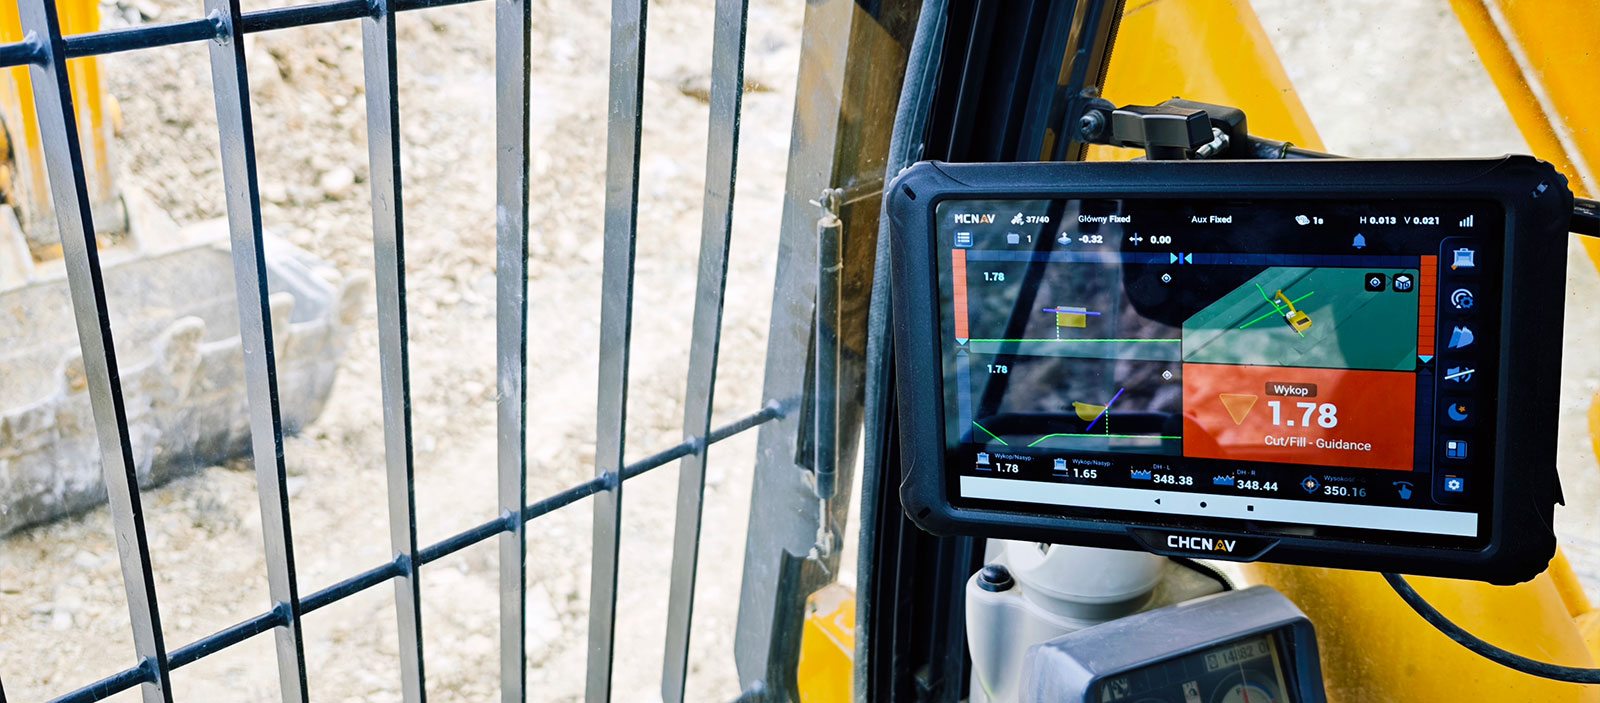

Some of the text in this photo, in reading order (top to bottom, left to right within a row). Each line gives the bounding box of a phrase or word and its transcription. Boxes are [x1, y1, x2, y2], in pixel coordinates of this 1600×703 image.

[954, 213, 996, 225] MCNAV
[1025, 215, 1050, 224] 37/40
[1078, 213, 1131, 225] Główny Fixed
[1191, 215, 1232, 225] Aux Fixed
[1312, 216, 1324, 225] 1s
[1359, 216, 1440, 225] H 0.013 V 0.021
[1026, 235, 1032, 243] 1
[1078, 235, 1103, 243] -0.32
[1150, 236, 1172, 244] 0.00
[983, 272, 1005, 282] 1.78
[986, 364, 1008, 374] 1.78
[1273, 384, 1309, 397] Wykop
[1267, 400, 1338, 429] 1.78
[1264, 435, 1307, 448] Cut/Fill
[1315, 438, 1372, 452] Guidance
[995, 462, 1019, 474] 1.78
[1153, 473, 1194, 486] 348.38
[1237, 479, 1279, 492] 348.44
[1323, 485, 1367, 498] 350.16
[1167, 534, 1237, 553] CHCNAV
